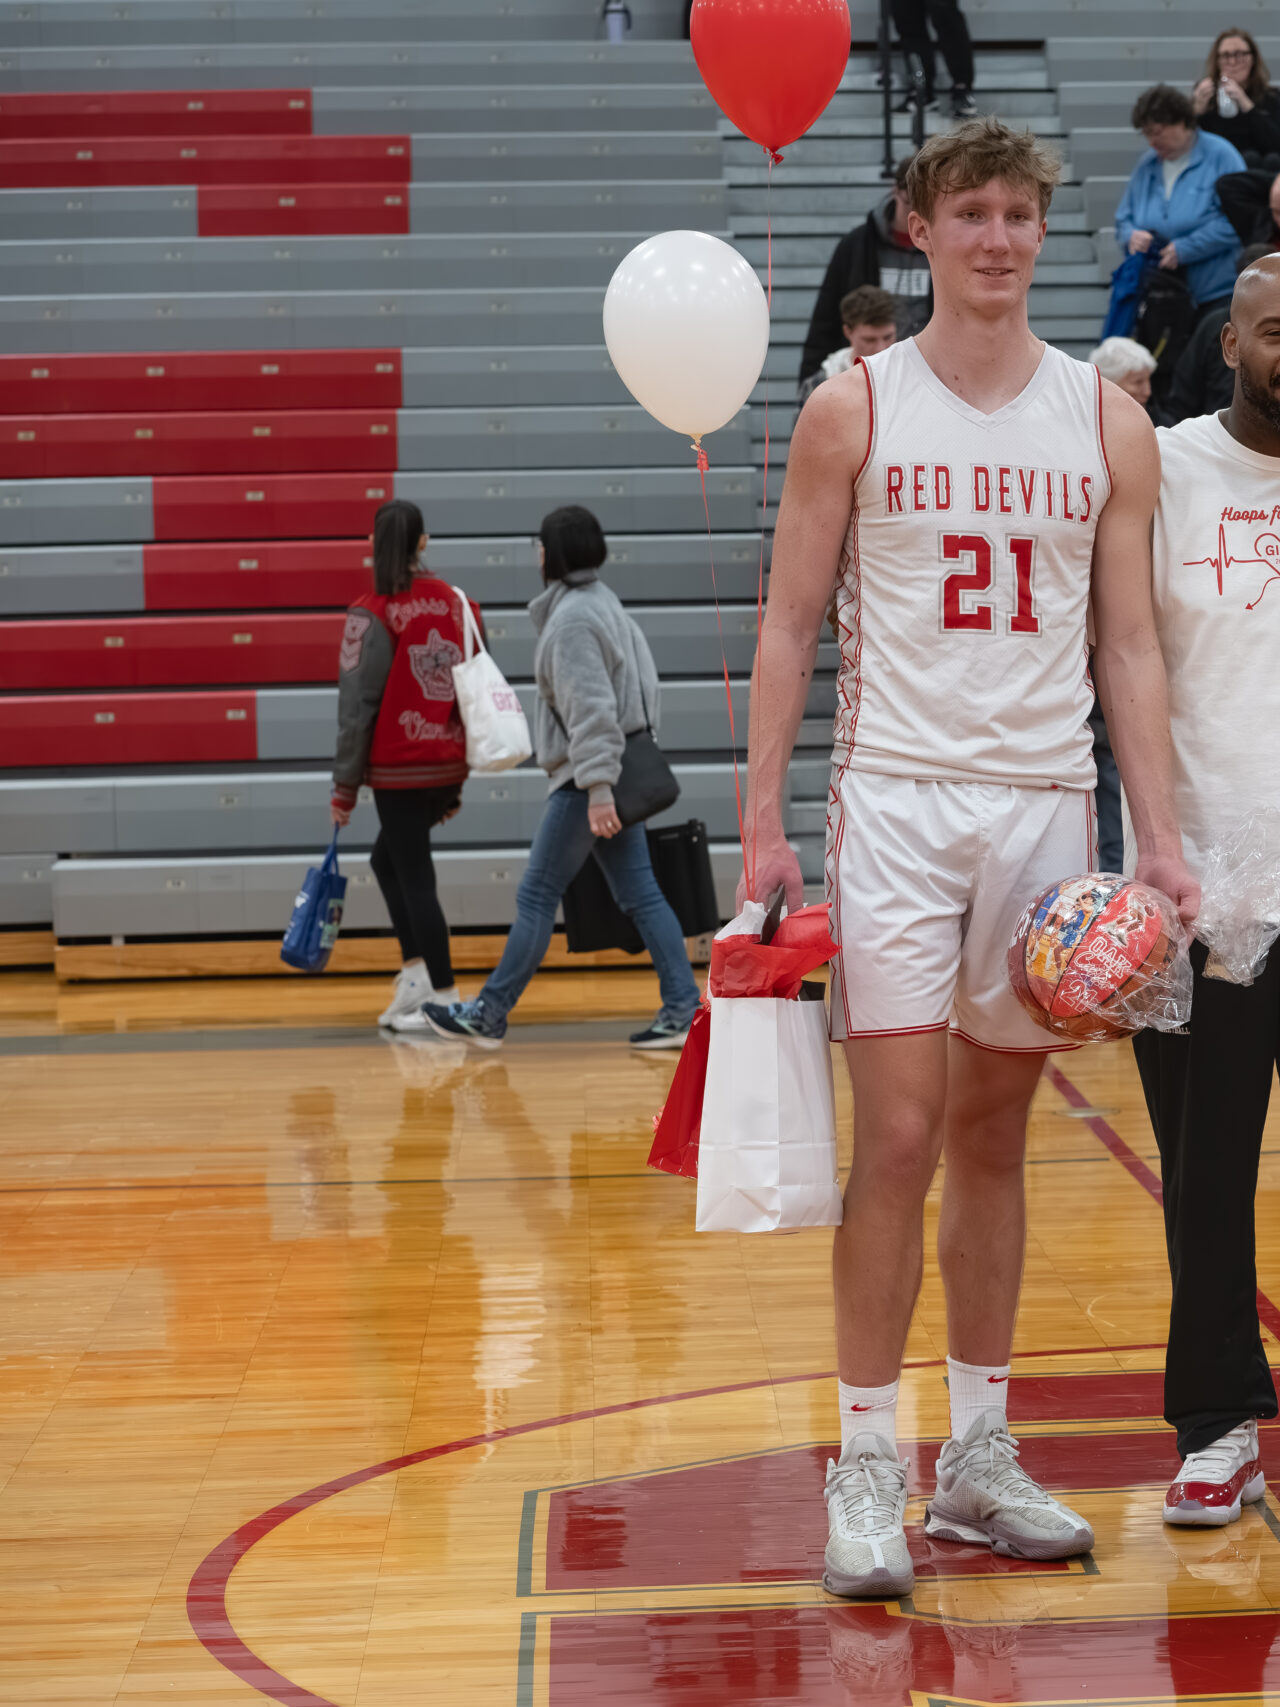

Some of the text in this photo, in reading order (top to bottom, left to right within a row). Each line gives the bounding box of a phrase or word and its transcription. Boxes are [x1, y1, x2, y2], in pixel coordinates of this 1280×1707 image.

[884, 463, 1094, 525] RED DEVILS
[1221, 507, 1268, 525] Hoops
[938, 530, 1042, 638] 21
[1088, 936, 1132, 979] OAK
